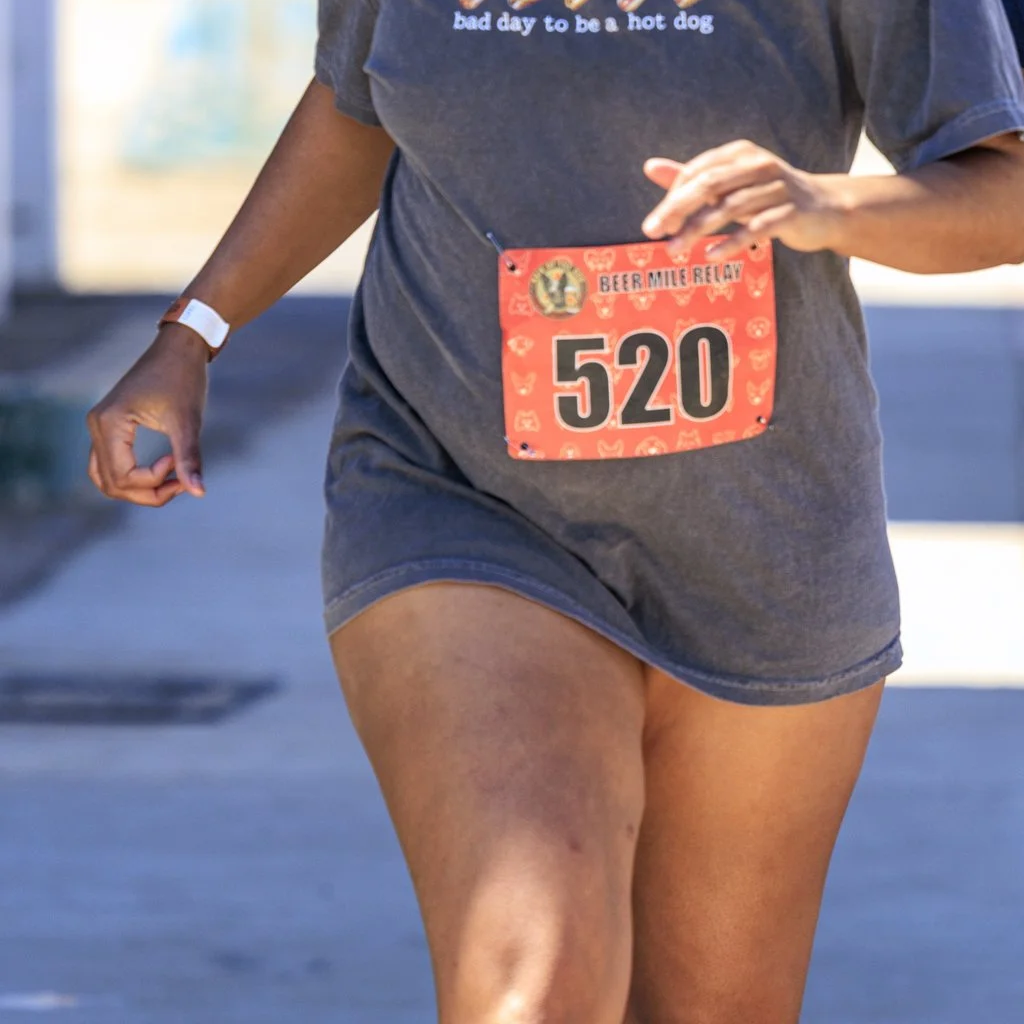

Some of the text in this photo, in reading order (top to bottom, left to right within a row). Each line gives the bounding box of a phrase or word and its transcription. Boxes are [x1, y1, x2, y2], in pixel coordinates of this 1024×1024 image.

[453, 11, 714, 36] bad day to be a hot dog
[599, 260, 744, 294] BEER MILE RELAY
[552, 323, 733, 433] 520
